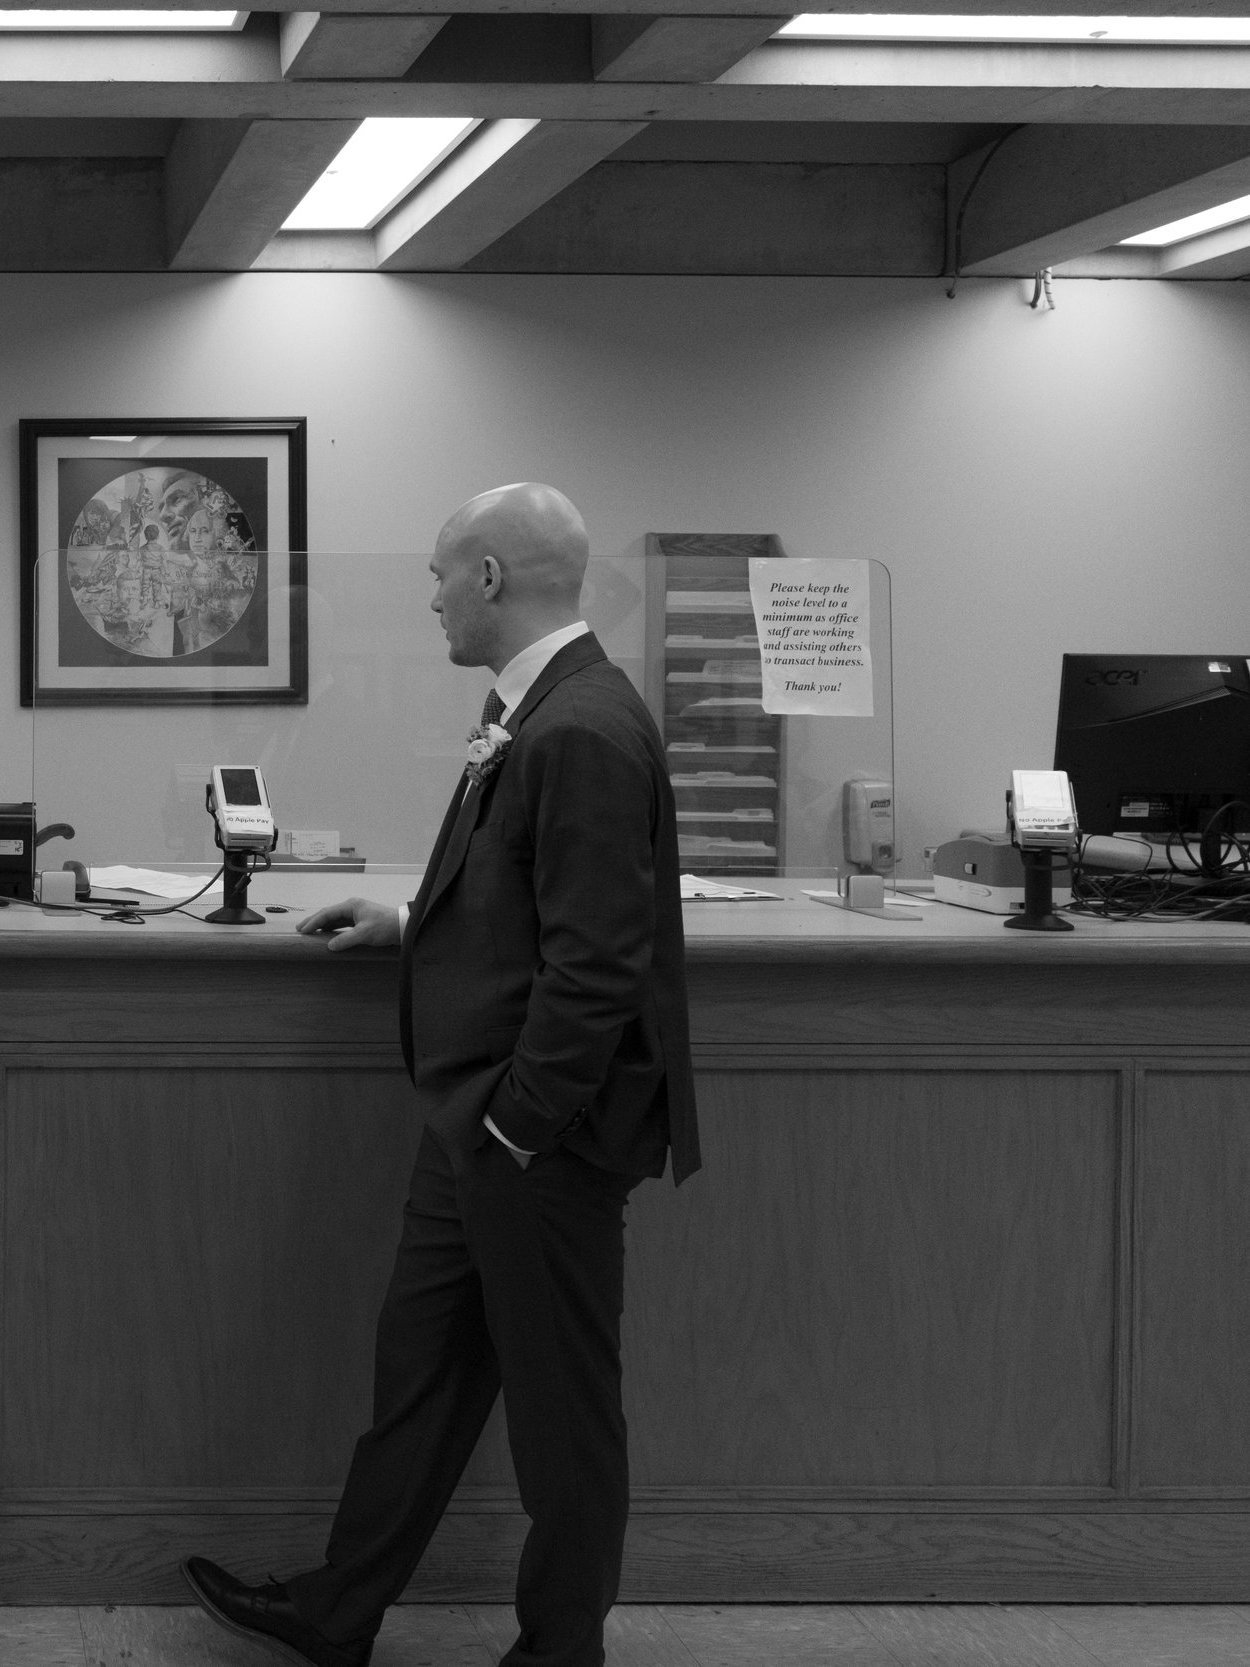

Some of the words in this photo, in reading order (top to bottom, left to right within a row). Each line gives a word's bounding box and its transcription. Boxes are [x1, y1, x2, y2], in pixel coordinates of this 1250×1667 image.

[770, 582, 805, 593] Please
[807, 583, 830, 595] keep
[833, 583, 849, 593] the
[771, 597, 800, 607] noise
[802, 597, 826, 608] level
[828, 599, 838, 608] to
[841, 600, 848, 608] a
[762, 612, 812, 621] minimum
[828, 612, 859, 625] office
[767, 626, 792, 639] staff
[813, 627, 854, 639] working
[763, 641, 781, 650] and
[783, 641, 827, 654] assisting
[829, 642, 862, 652] others
[773, 656, 815, 666] transact
[817, 656, 864, 666] business.
[784, 680, 815, 691] Thank
[817, 682, 842, 694] you!
